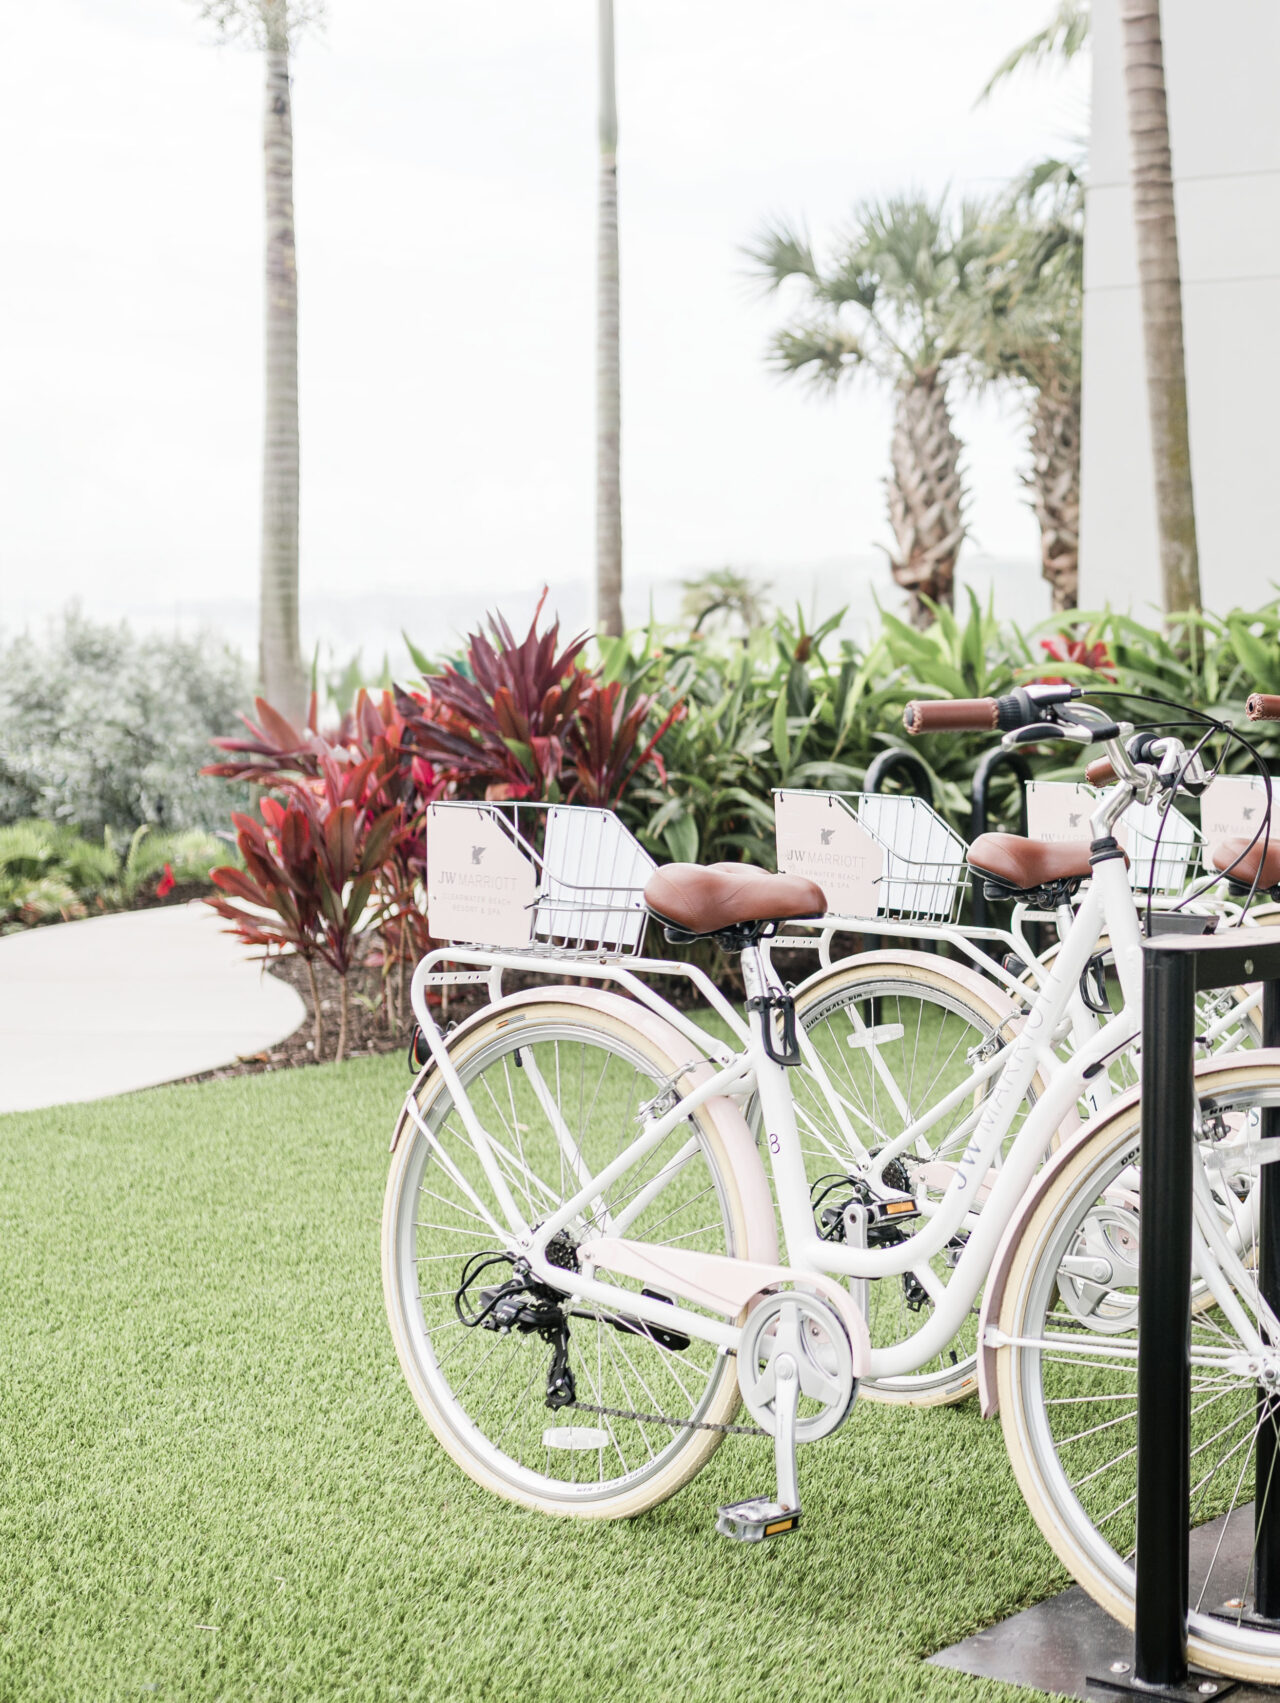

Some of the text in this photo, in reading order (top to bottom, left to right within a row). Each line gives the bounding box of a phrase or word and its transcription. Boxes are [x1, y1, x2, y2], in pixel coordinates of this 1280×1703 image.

[1211, 823, 1229, 833] JW
[786, 849, 866, 868] JW MARRIOTT
[438, 871, 517, 890] JW MARRIOTT
[769, 1133, 781, 1154] 8
